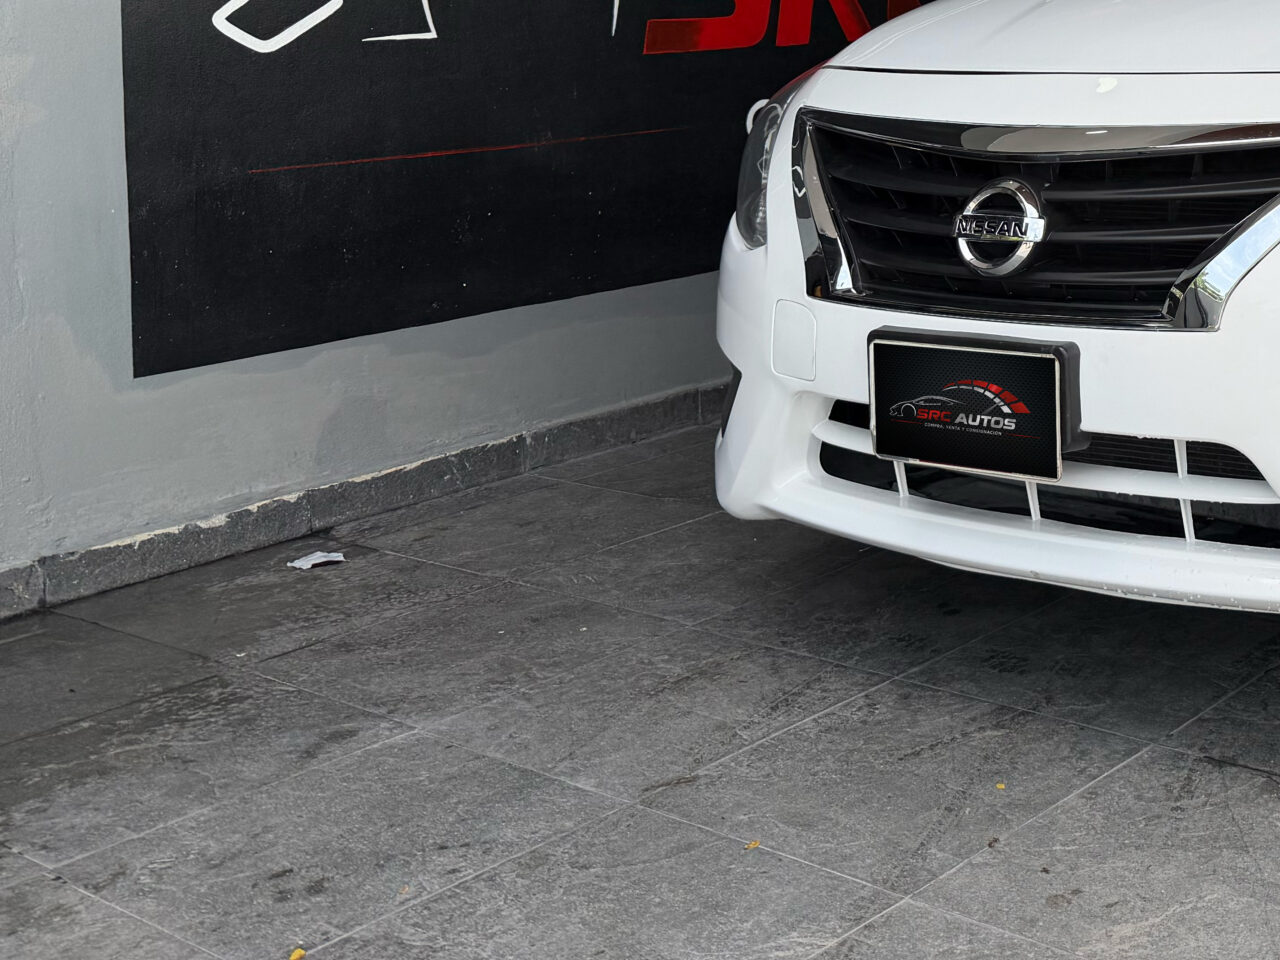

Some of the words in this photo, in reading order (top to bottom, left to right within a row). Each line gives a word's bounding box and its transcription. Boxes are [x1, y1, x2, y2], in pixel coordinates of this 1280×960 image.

[956, 217, 1029, 239] NISSAN
[917, 408, 952, 422] SRC
[954, 413, 1017, 430] AUTOS
